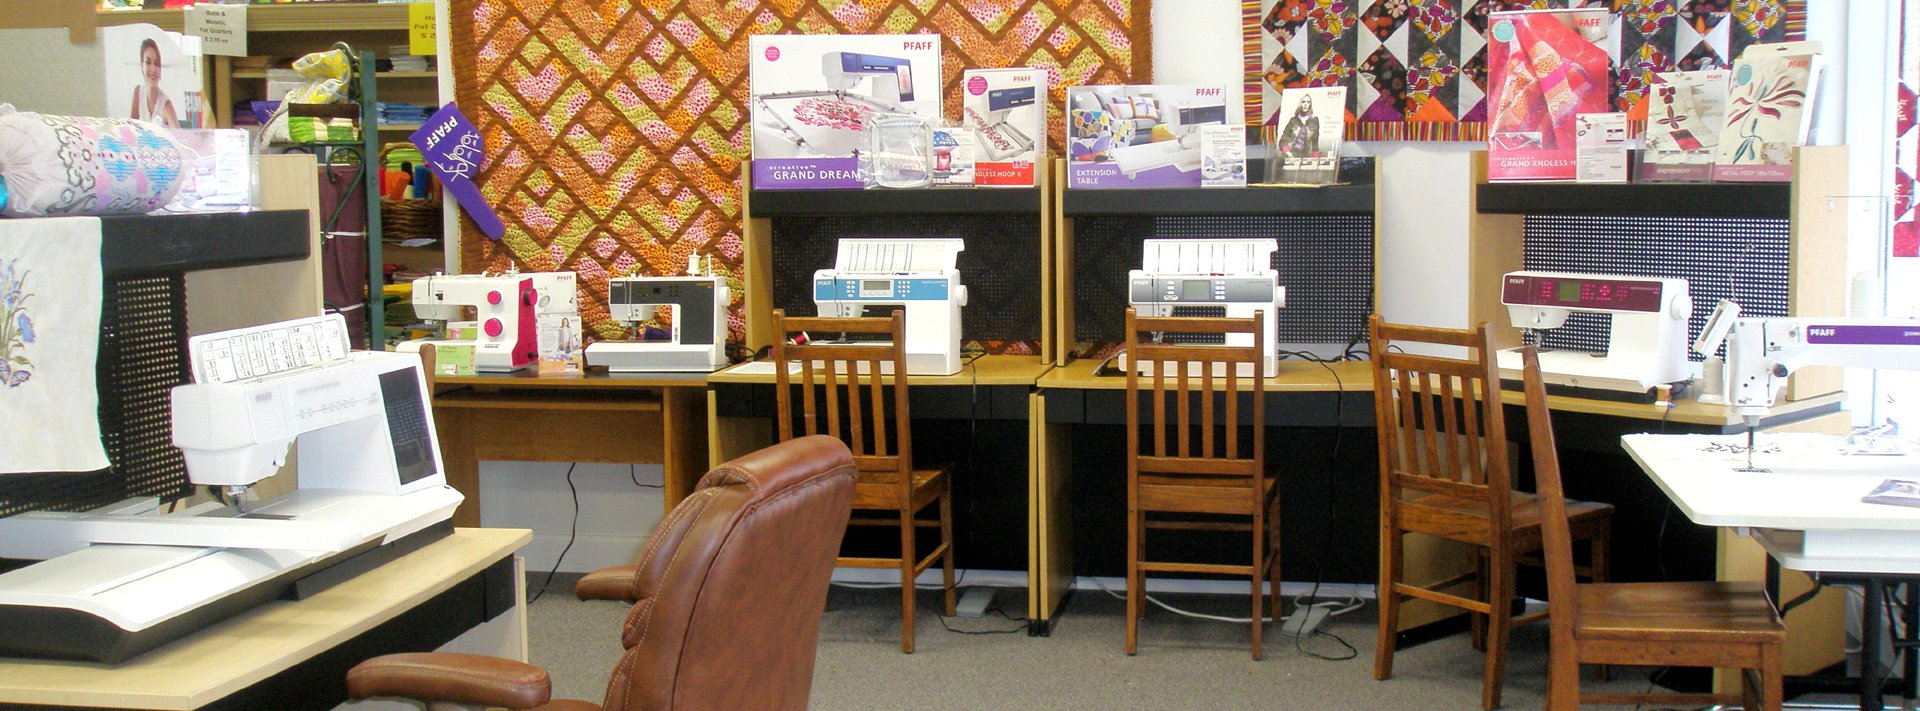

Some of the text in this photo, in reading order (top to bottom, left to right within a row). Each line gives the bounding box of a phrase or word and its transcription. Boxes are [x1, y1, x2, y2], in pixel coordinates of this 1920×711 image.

[1573, 18, 1601, 27] PFAFF
[903, 41, 933, 51] PFAFF
[1195, 88, 1221, 96] PFAFF
[426, 115, 459, 149] PFAFF
[1533, 159, 1568, 167] ENDLESS
[773, 170, 816, 180] GRAND
[1076, 169, 1117, 177] EXTENSION
[1076, 177, 1099, 185] TABLE
[1810, 328, 1836, 337] PFAFF
